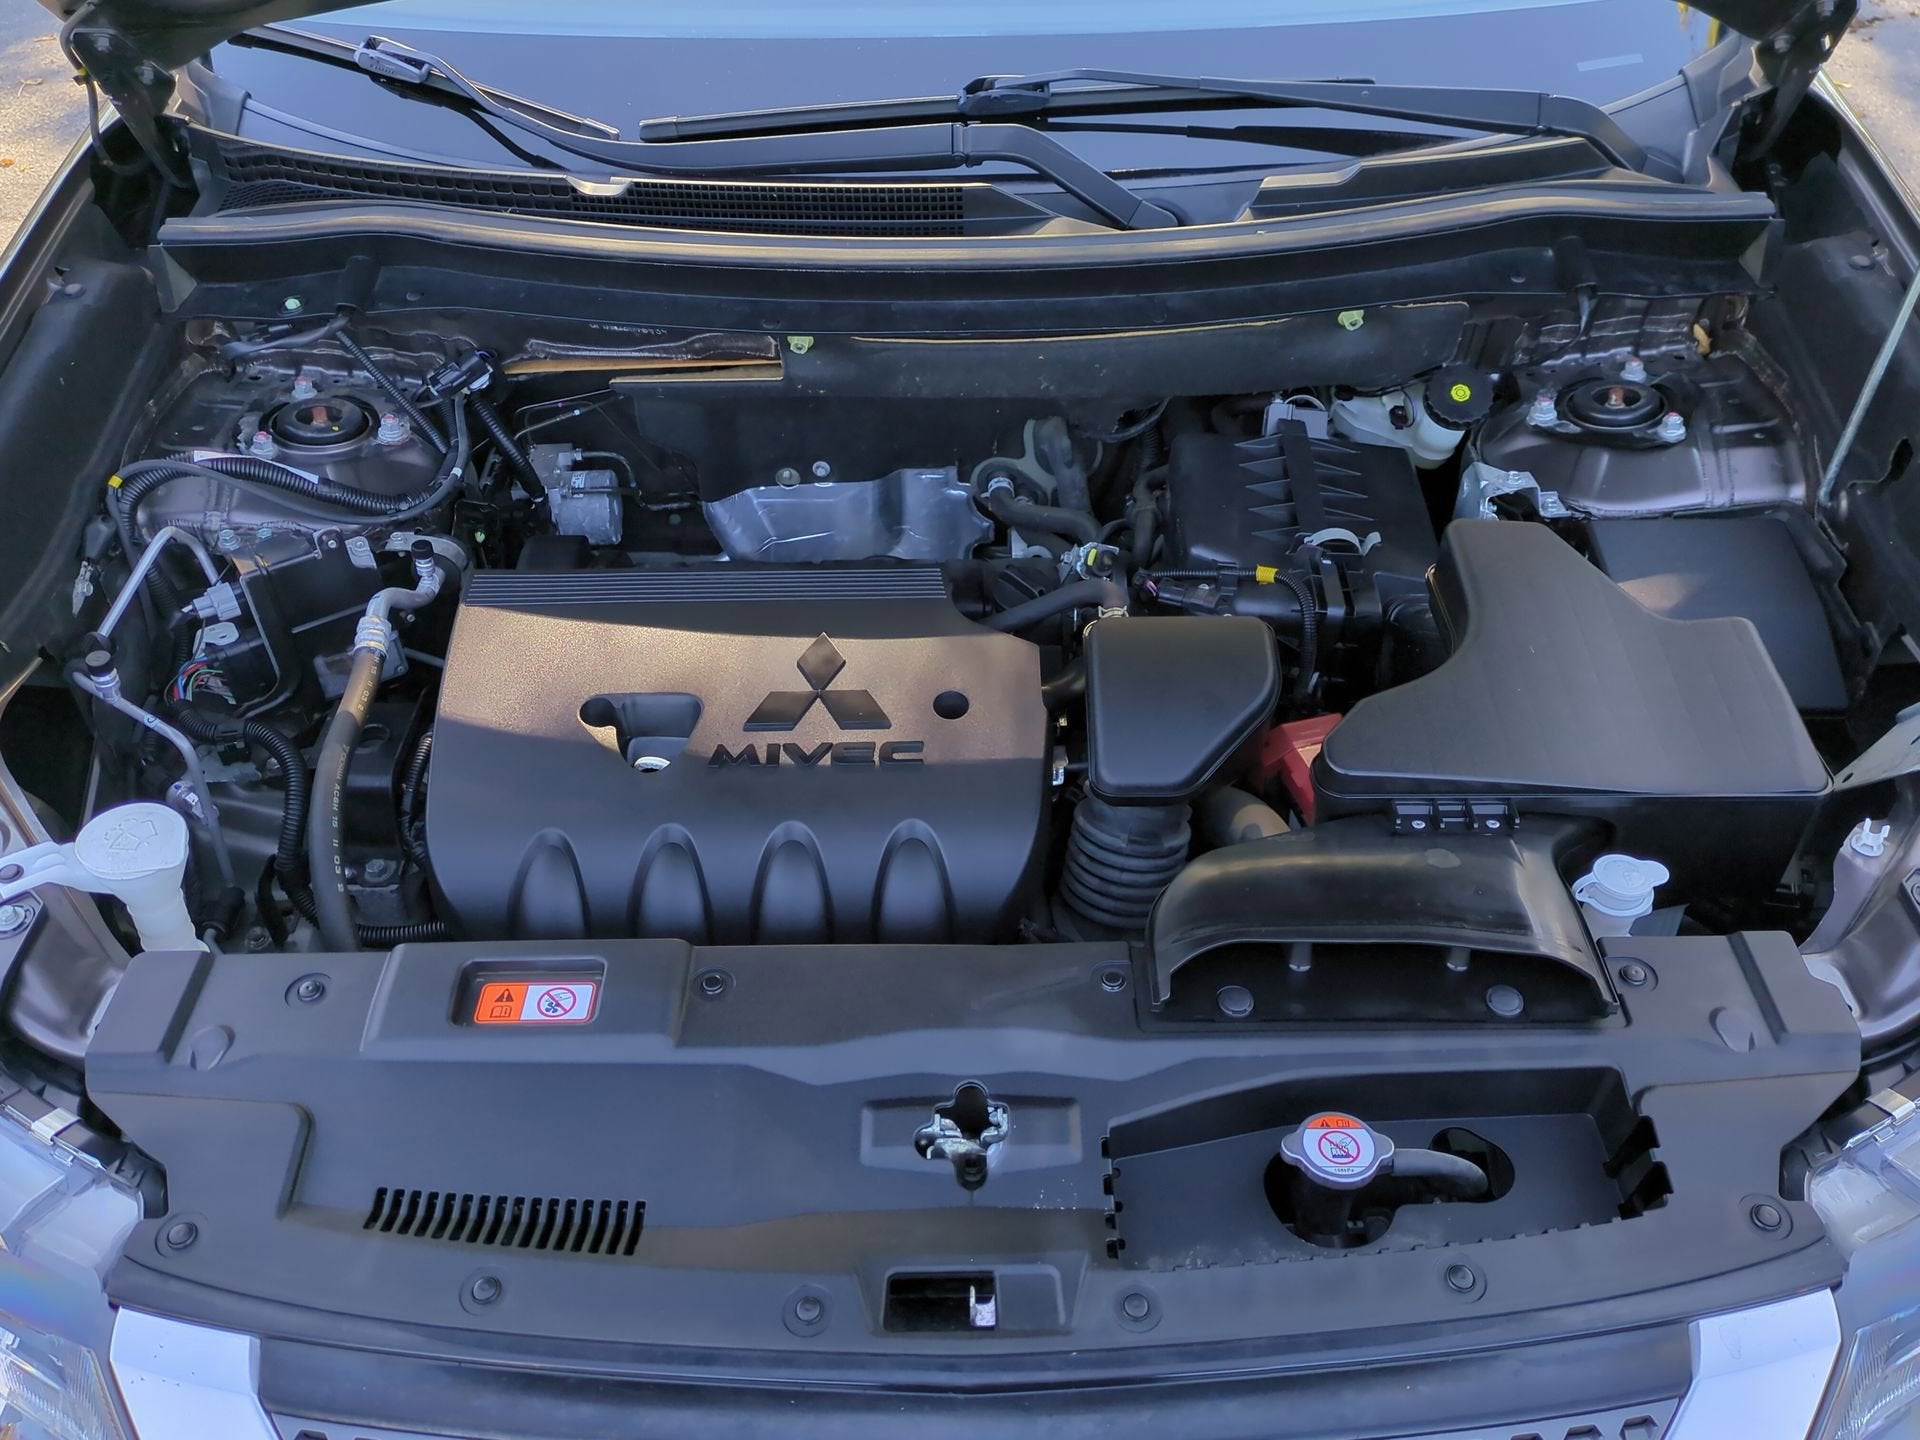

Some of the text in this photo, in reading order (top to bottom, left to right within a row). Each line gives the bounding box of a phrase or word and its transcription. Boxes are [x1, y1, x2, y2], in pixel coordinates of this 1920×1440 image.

[361, 690, 370, 702] 03
[707, 740, 926, 768] MIVEC
[333, 855, 342, 874] 03
